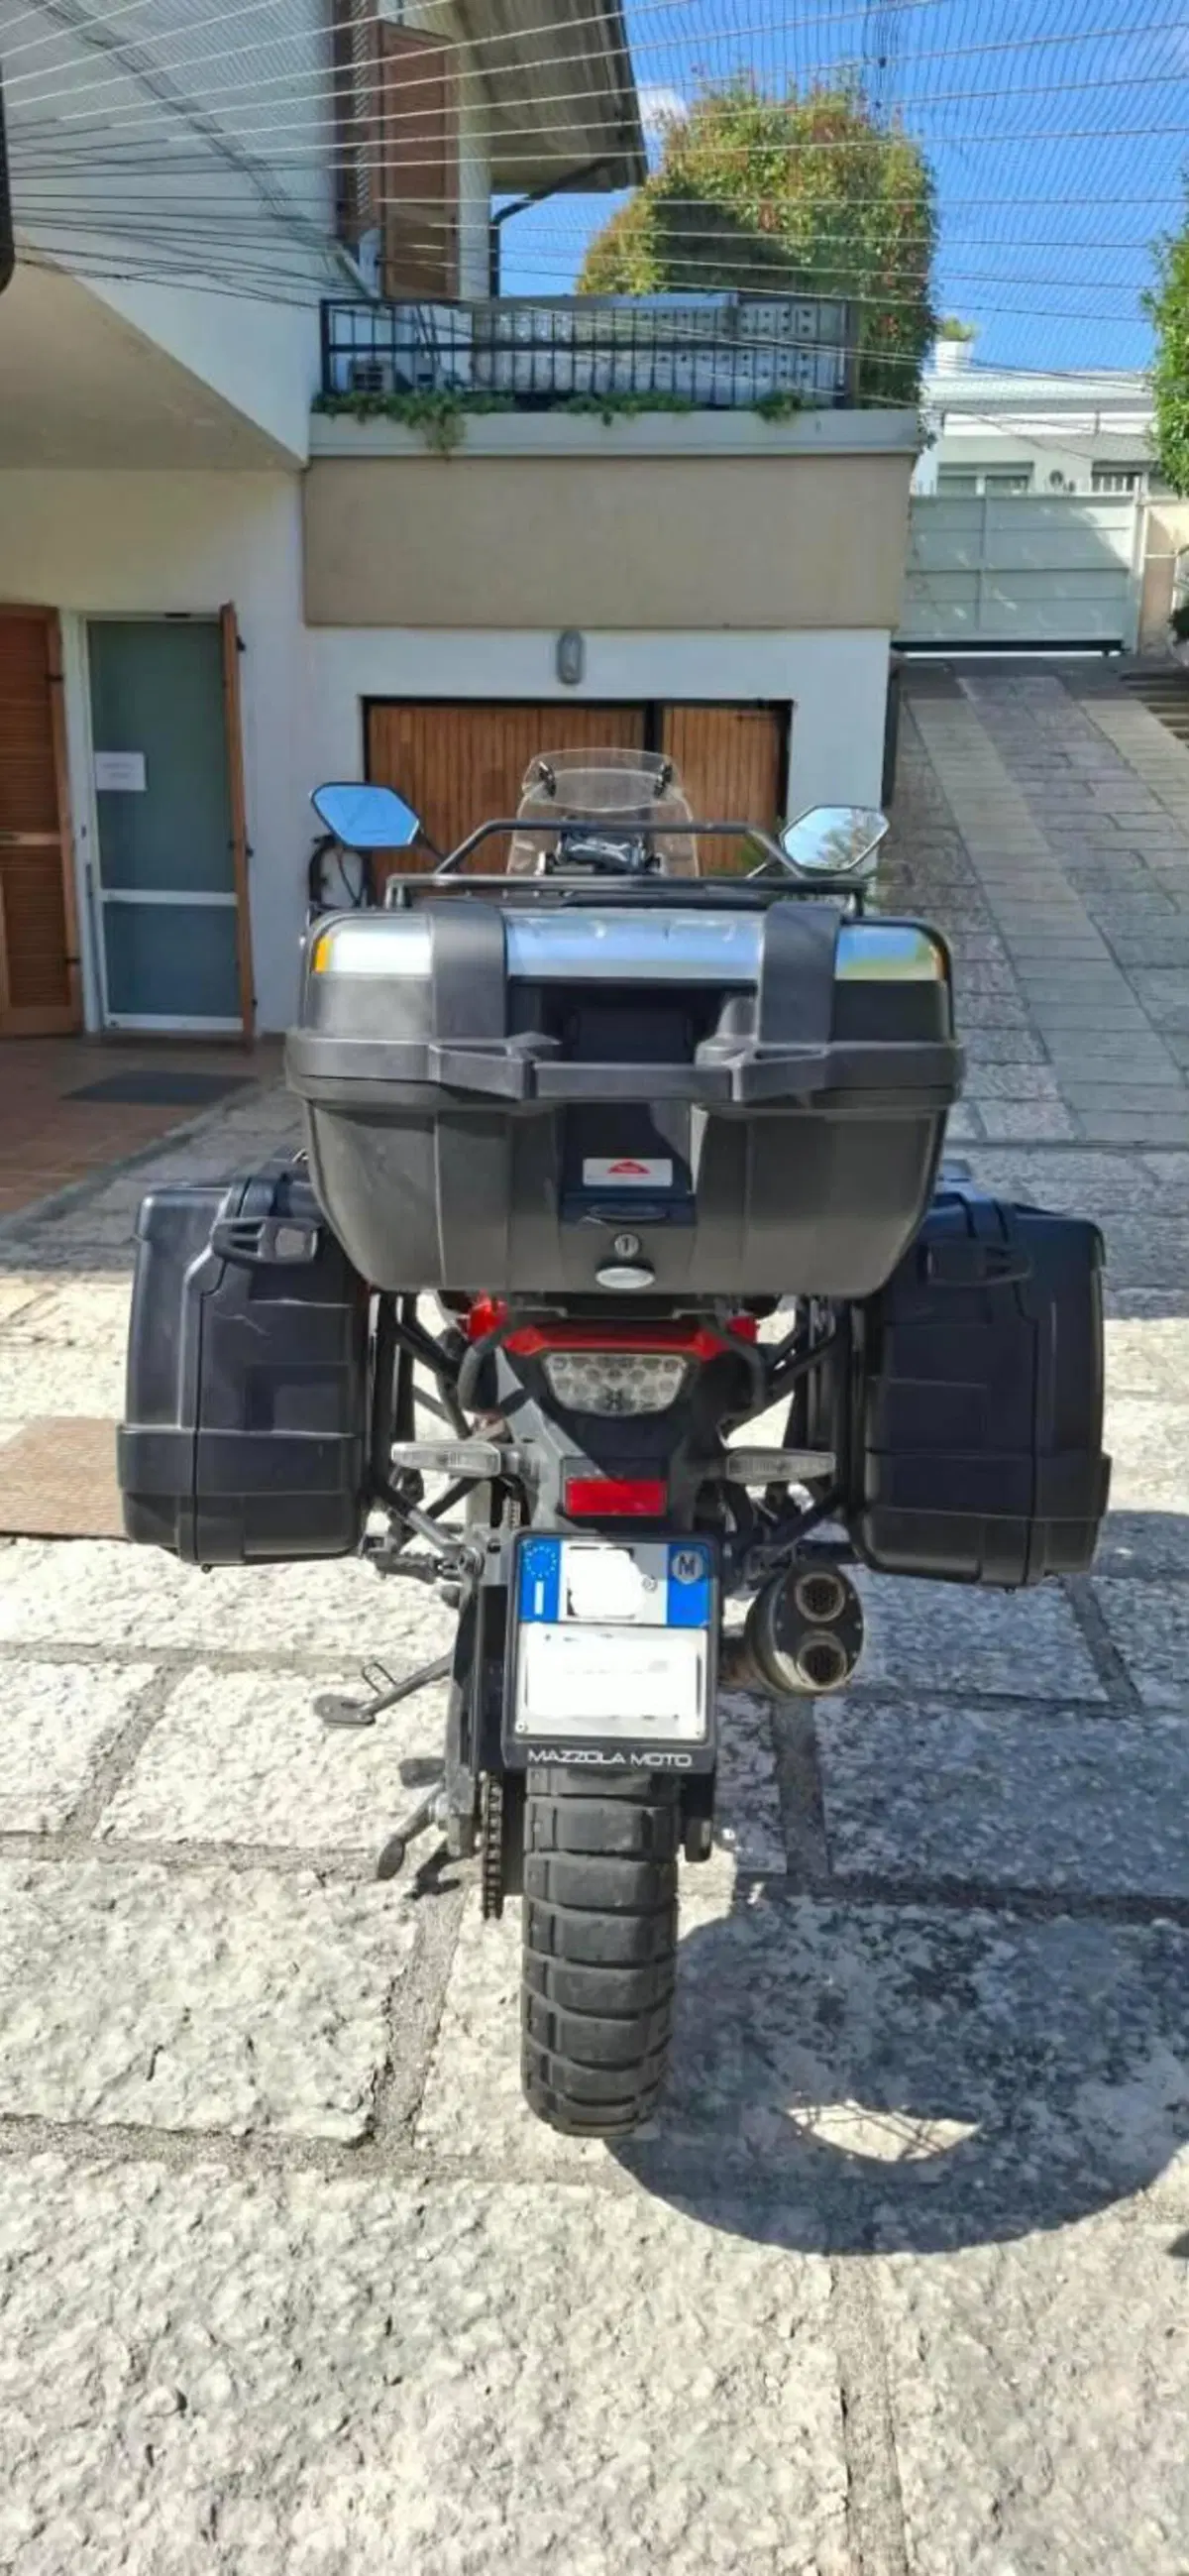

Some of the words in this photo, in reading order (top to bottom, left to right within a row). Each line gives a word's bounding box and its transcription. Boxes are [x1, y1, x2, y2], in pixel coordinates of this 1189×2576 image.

[678, 1554, 696, 1576] M
[527, 1749, 626, 1764] MAZZOLA
[630, 1752, 693, 1767] MOTO
